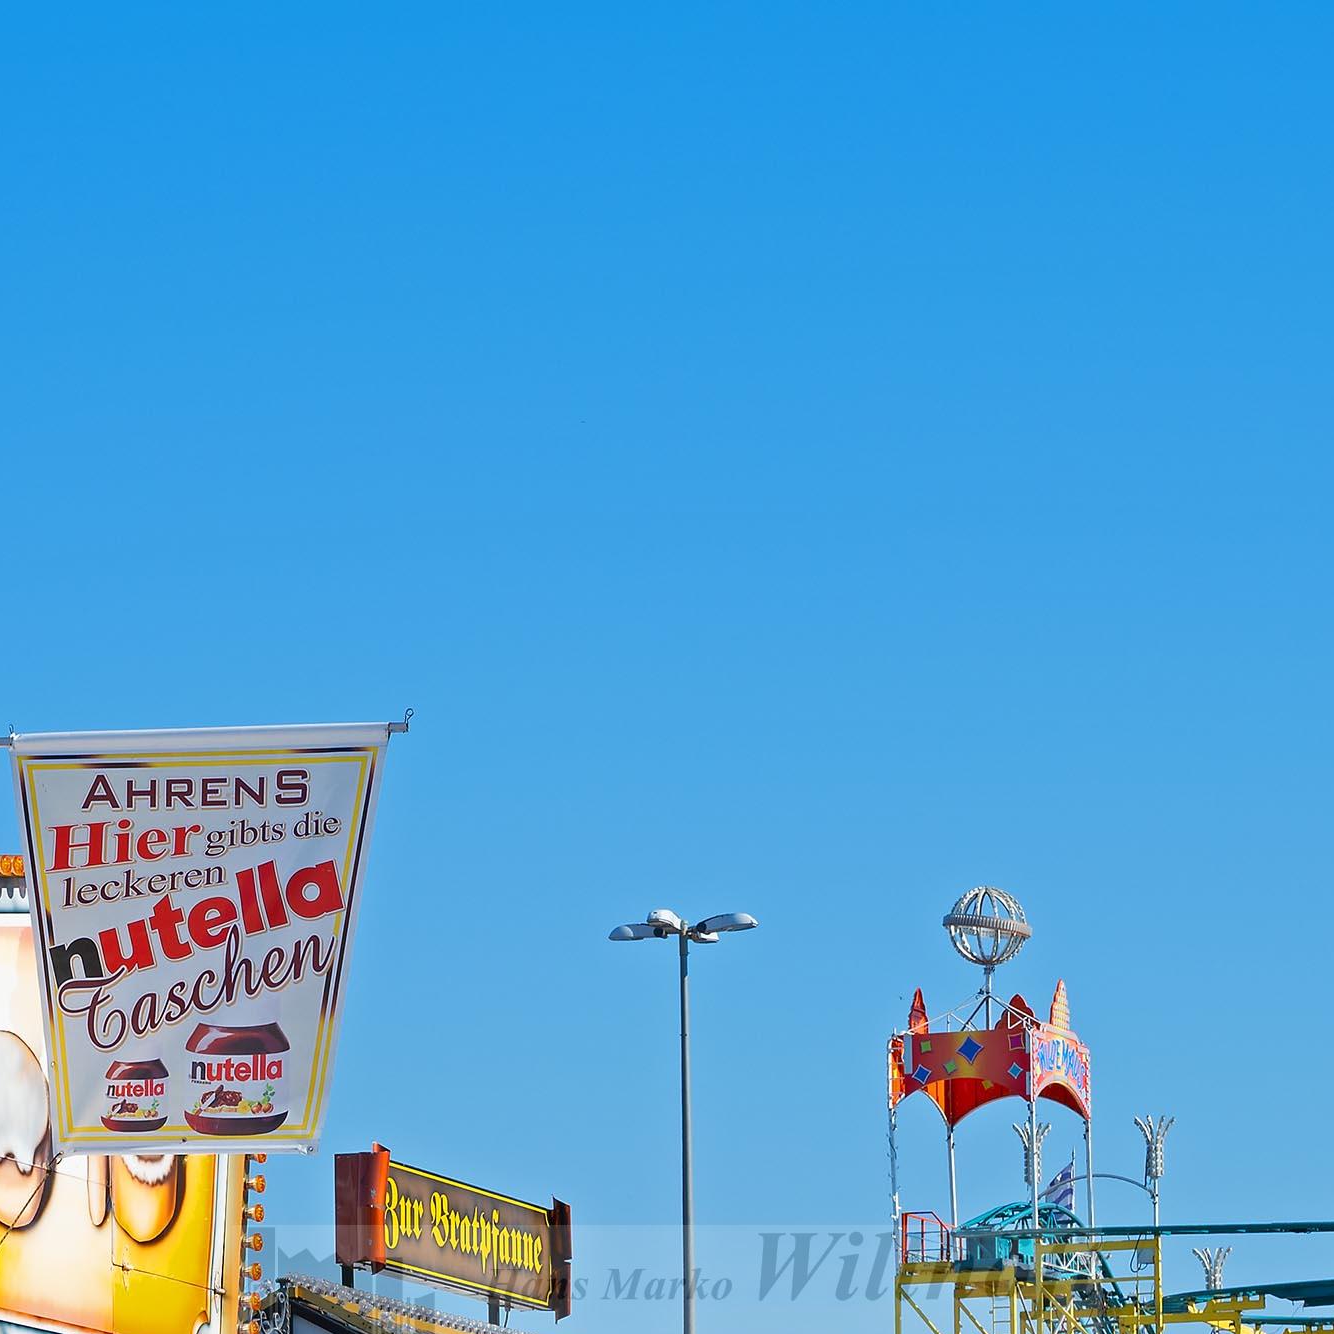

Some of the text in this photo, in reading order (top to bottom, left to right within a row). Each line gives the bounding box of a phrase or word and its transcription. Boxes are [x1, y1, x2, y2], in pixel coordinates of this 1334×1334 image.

[81, 769, 310, 810] AHRENS
[46, 809, 340, 872] Hier gibts die
[63, 862, 226, 909] leckeren
[49, 858, 346, 984] nutella
[58, 925, 336, 1051] Taschen
[106, 1078, 165, 1098] nutella
[191, 1054, 283, 1082] nutella
[384, 1177, 544, 1278] Zur Bratpfanne
